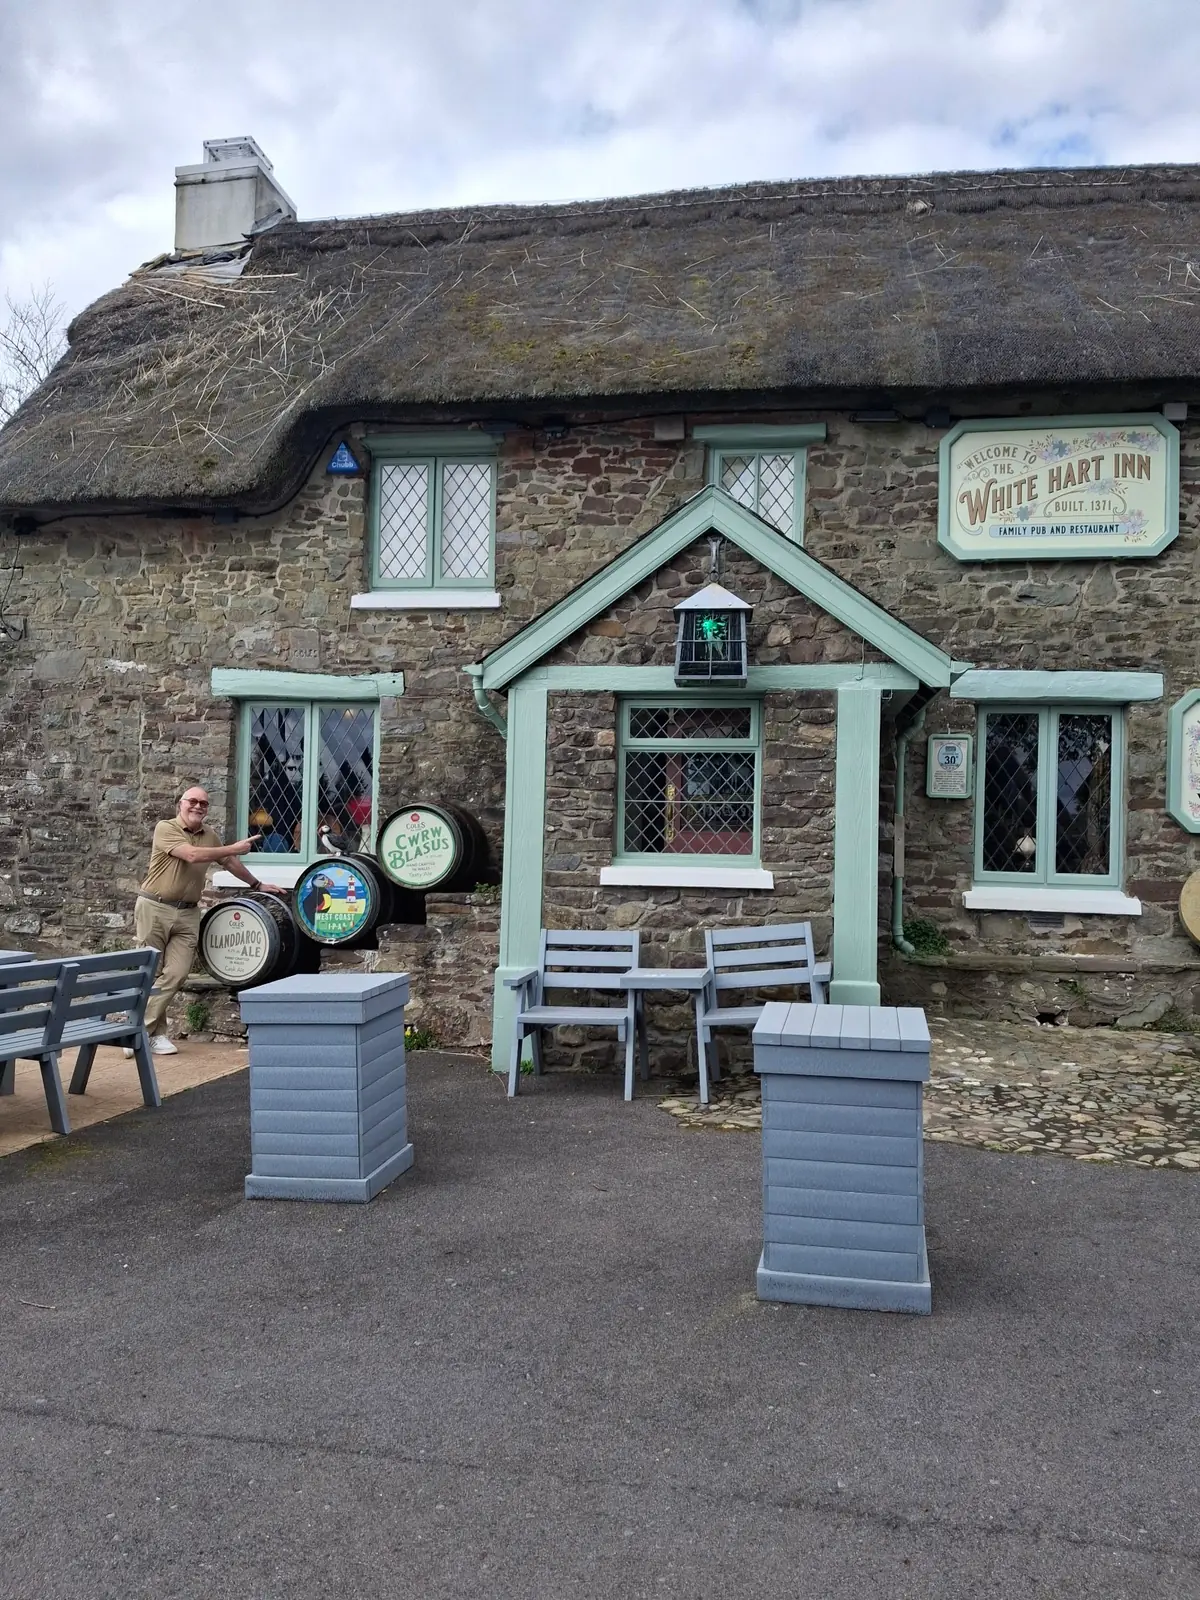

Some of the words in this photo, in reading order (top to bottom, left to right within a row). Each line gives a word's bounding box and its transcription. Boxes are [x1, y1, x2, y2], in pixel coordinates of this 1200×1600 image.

[964, 445, 1018, 470] WELCOME
[1022, 450, 1037, 465] TO
[331, 461, 354, 469] Chubb
[993, 463, 1015, 474] THE
[959, 474, 1038, 525] WHITE
[1048, 455, 1105, 493] HART
[1114, 453, 1151, 481] INN
[1091, 500, 1111, 511] 1371
[999, 526, 1028, 536] FAMILY
[1031, 525, 1047, 535] PUB
[1050, 525, 1066, 534] AND
[1070, 524, 1120, 534] RESTAURANT
[395, 826, 442, 850] CWRW
[388, 838, 450, 870] BLASUS
[334, 913, 355, 921] COAST
[210, 930, 262, 949] LLANDDAROG
[240, 945, 261, 958] ALE
